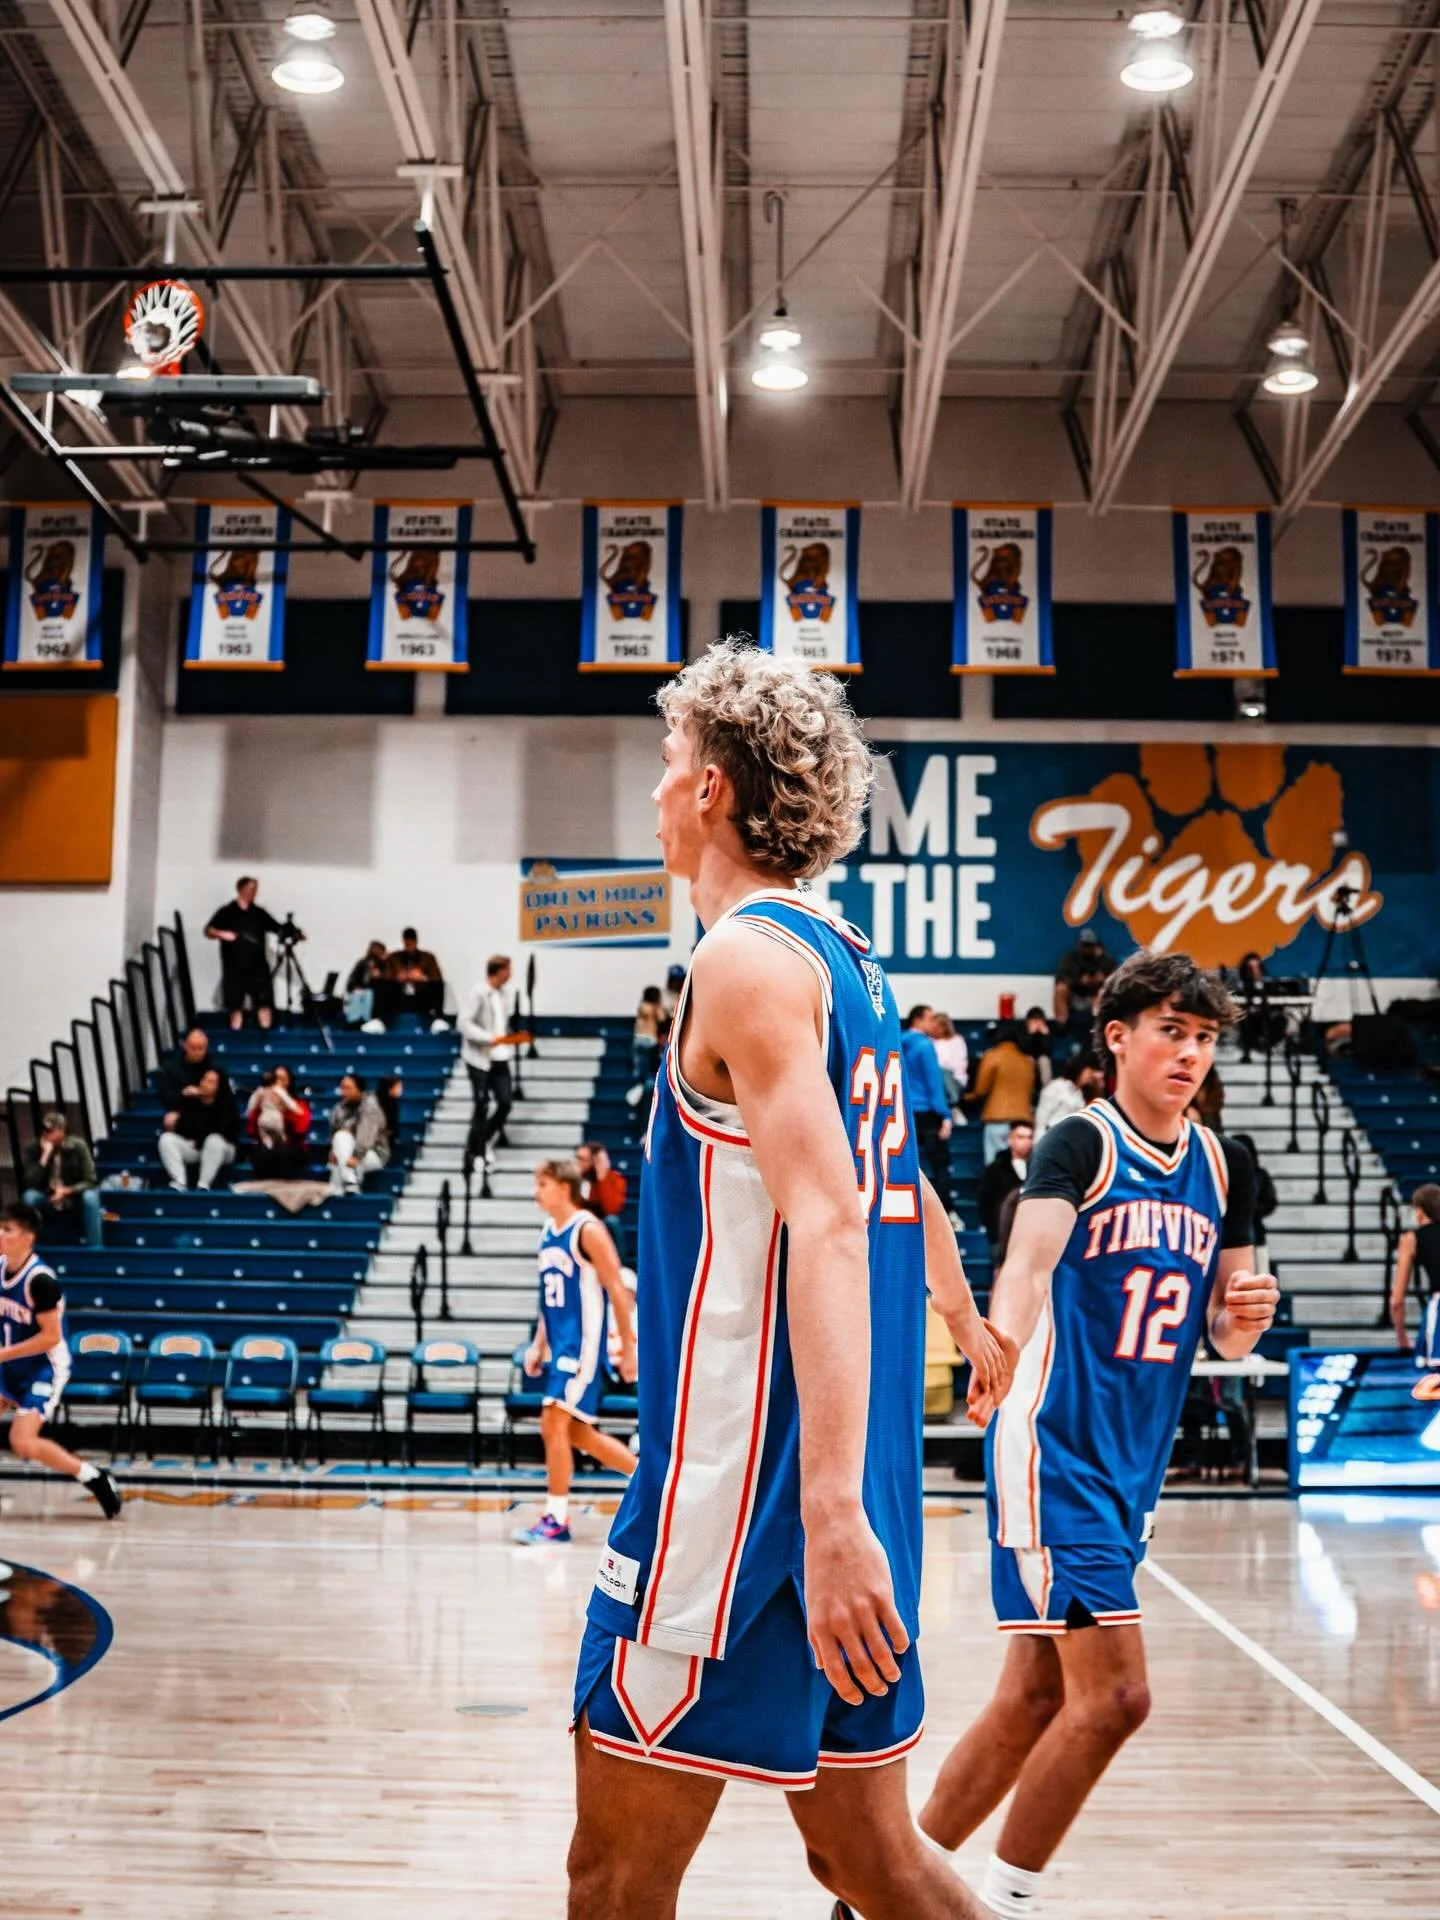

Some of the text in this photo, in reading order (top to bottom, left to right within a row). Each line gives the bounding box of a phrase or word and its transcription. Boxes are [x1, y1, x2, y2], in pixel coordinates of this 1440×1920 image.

[868, 754, 998, 857] ME
[535, 908, 657, 931] PATRONS
[859, 863, 996, 959] THE
[1035, 801, 1380, 952] Tigers
[850, 1046, 921, 1224] 32
[1112, 1265, 1192, 1364] 12
